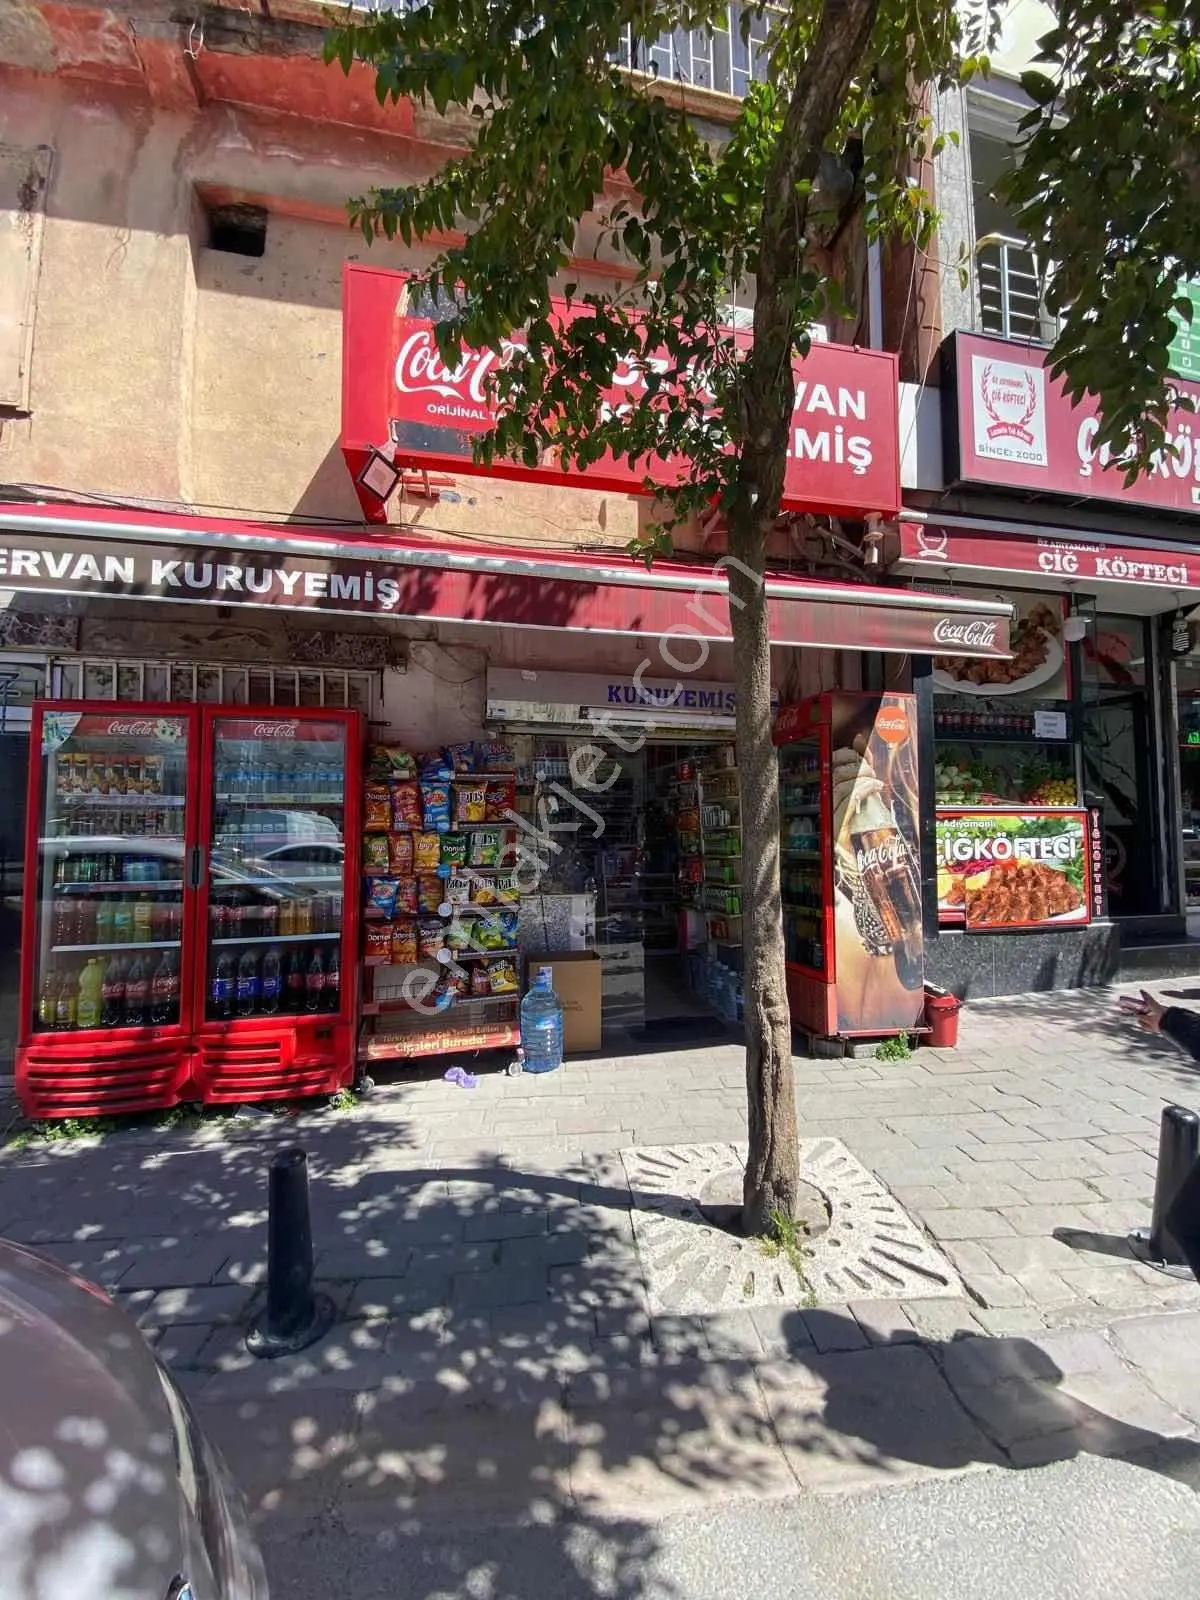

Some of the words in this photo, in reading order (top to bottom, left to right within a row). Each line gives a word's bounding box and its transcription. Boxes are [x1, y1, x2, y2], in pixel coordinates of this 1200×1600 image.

[1016, 450, 1043, 462] 2000
[1038, 549, 1079, 573] ÇİĞ
[1095, 556, 1189, 584] KÖFTECİ
[151, 559, 400, 609] KURUYEMİŞ
[607, 684, 737, 714] KURUYEMİŞ
